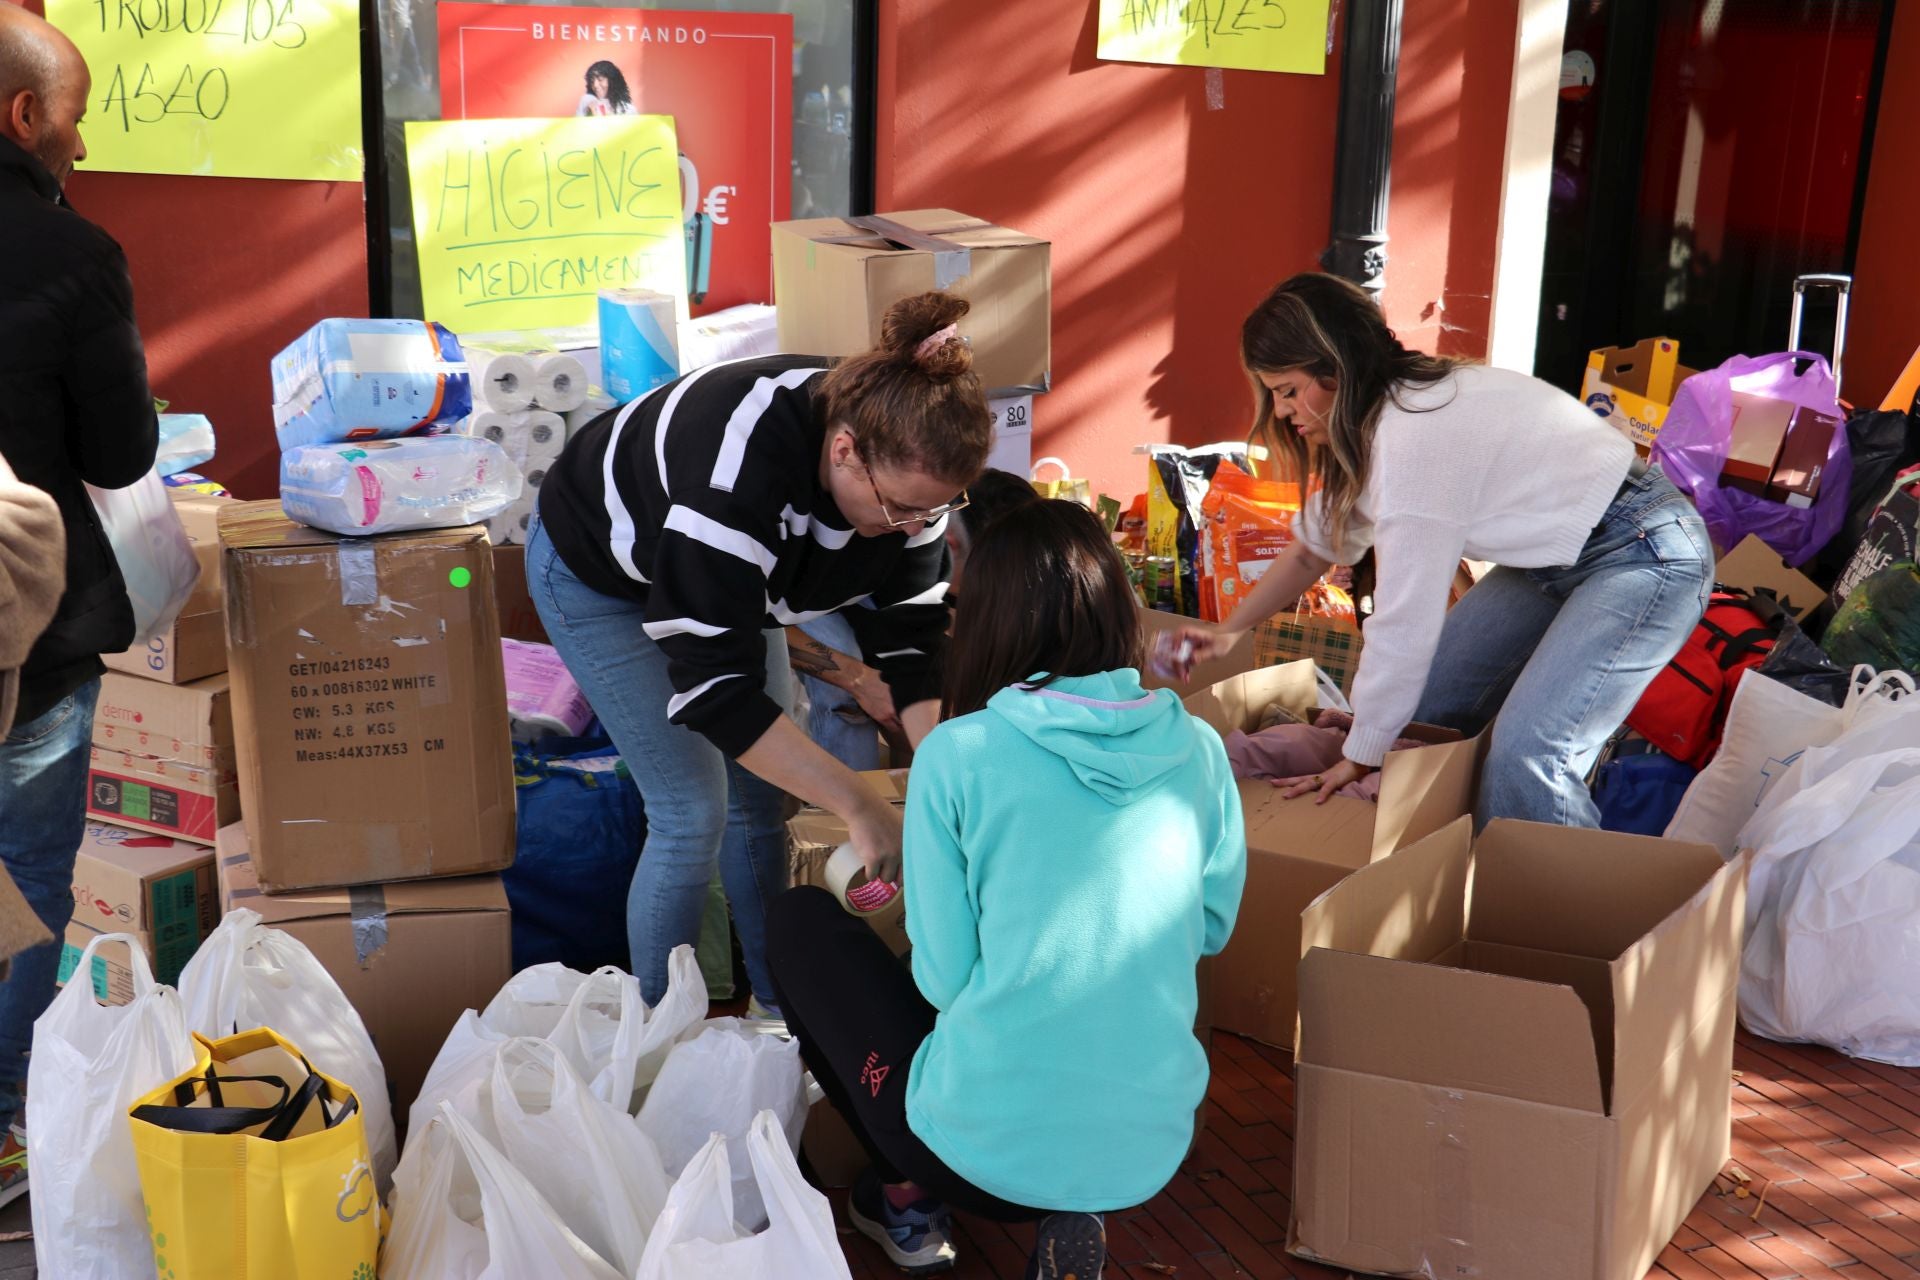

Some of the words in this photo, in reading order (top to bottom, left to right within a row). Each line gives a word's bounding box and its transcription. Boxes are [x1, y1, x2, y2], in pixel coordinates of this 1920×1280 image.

[532, 23, 707, 45] BIENESTANDO
[100, 63, 229, 132] ASEO
[437, 138, 675, 236] HIGIENE
[1007, 405, 1025, 421] 80
[291, 685, 308, 698] 60
[391, 675, 436, 690] WHITE
[332, 704, 353, 716] 5.3
[366, 701, 395, 714] KGS
[332, 726, 354, 738] 4.8
[367, 722, 396, 735] KGS
[424, 739, 444, 751] CM
